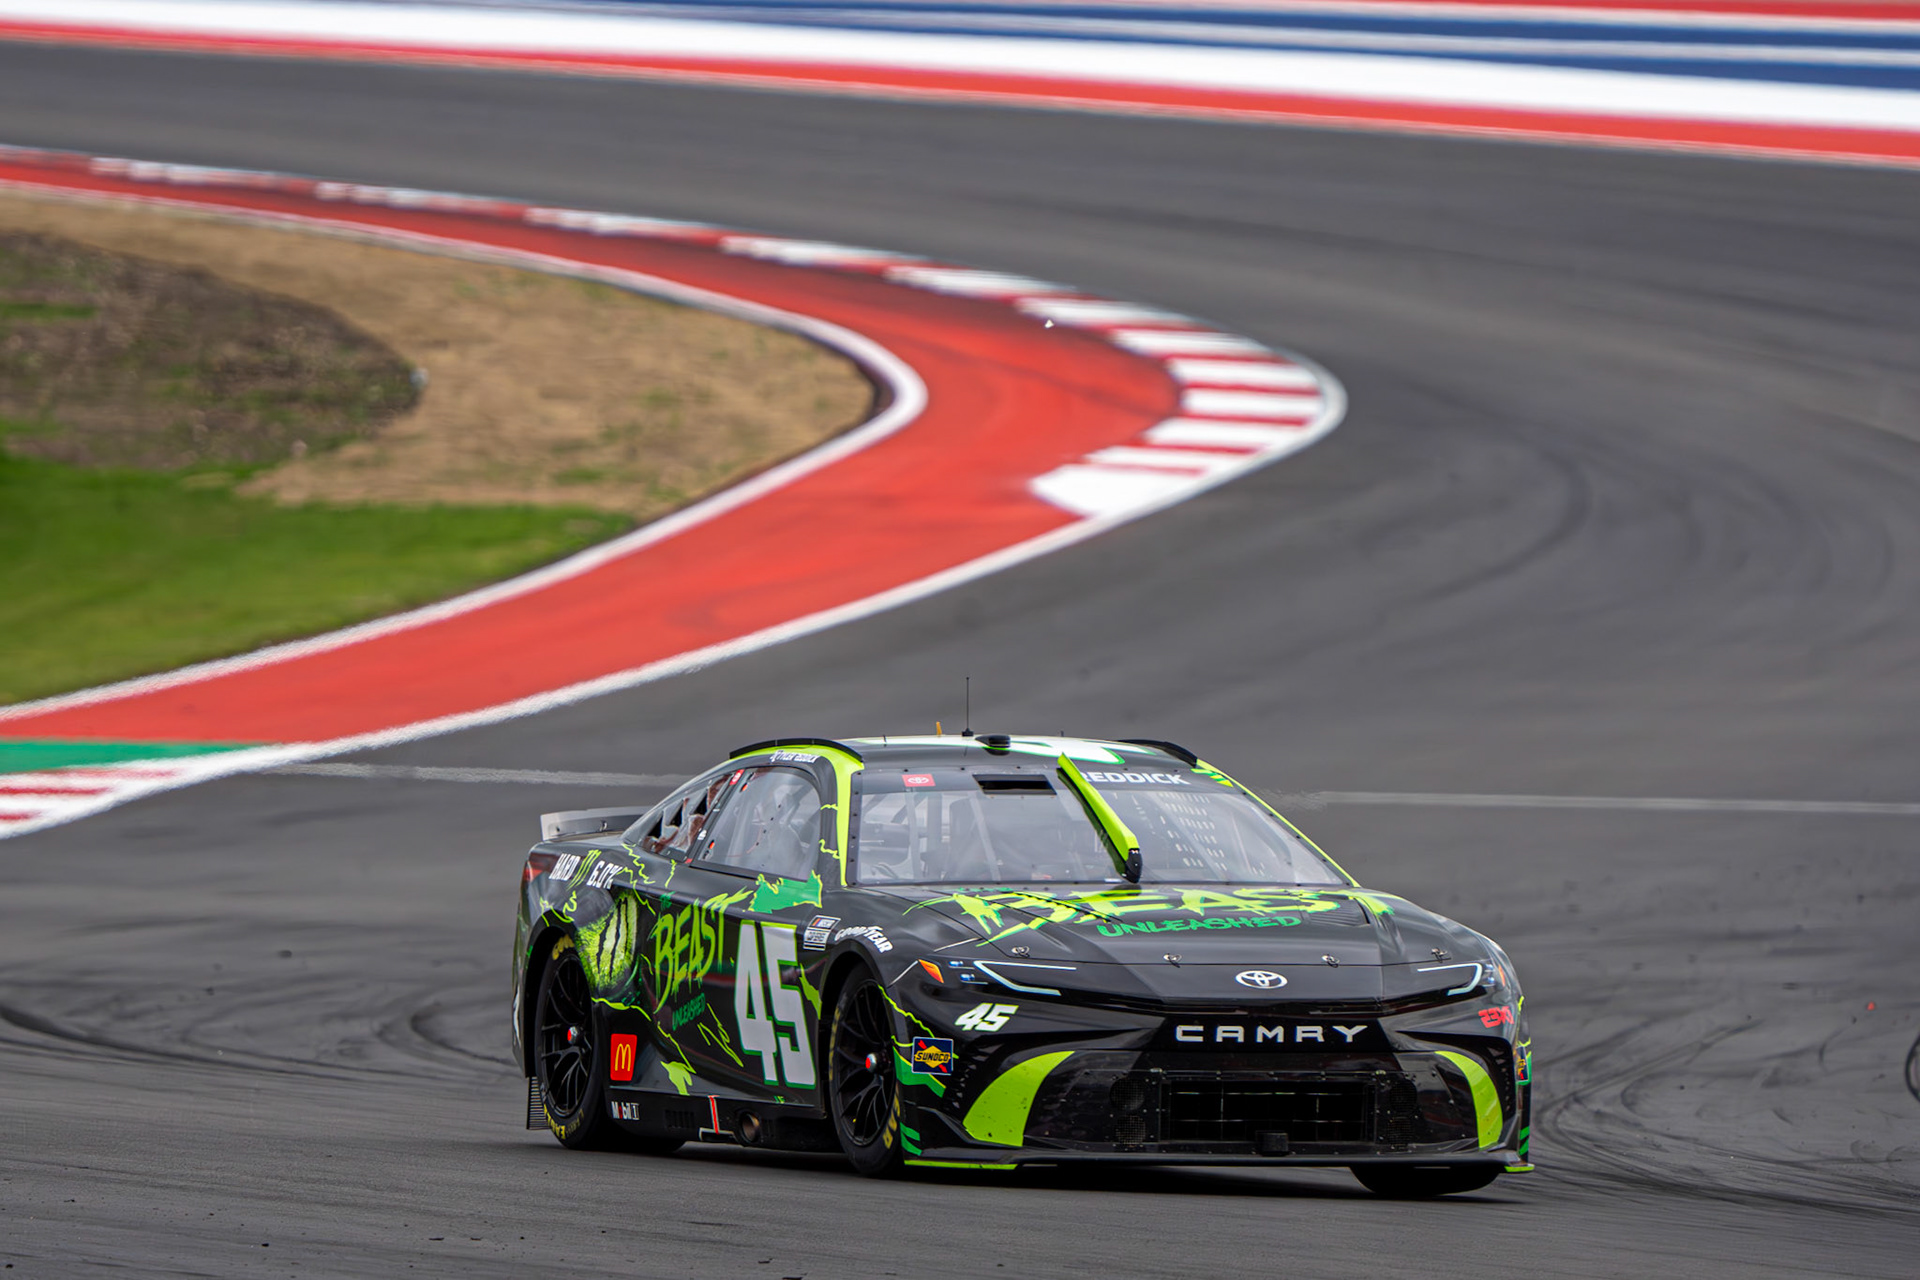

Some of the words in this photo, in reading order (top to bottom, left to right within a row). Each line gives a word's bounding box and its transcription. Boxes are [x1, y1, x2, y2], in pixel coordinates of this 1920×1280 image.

[834, 925, 893, 953] GOODYEAR
[1096, 914, 1302, 937] UNLEASHED
[647, 886, 754, 1014] BEAST
[734, 919, 818, 1090] 45
[954, 1002, 1019, 1032] 45
[1175, 1025, 1368, 1043] CAMRY
[916, 1052, 950, 1062] SUNOCO
